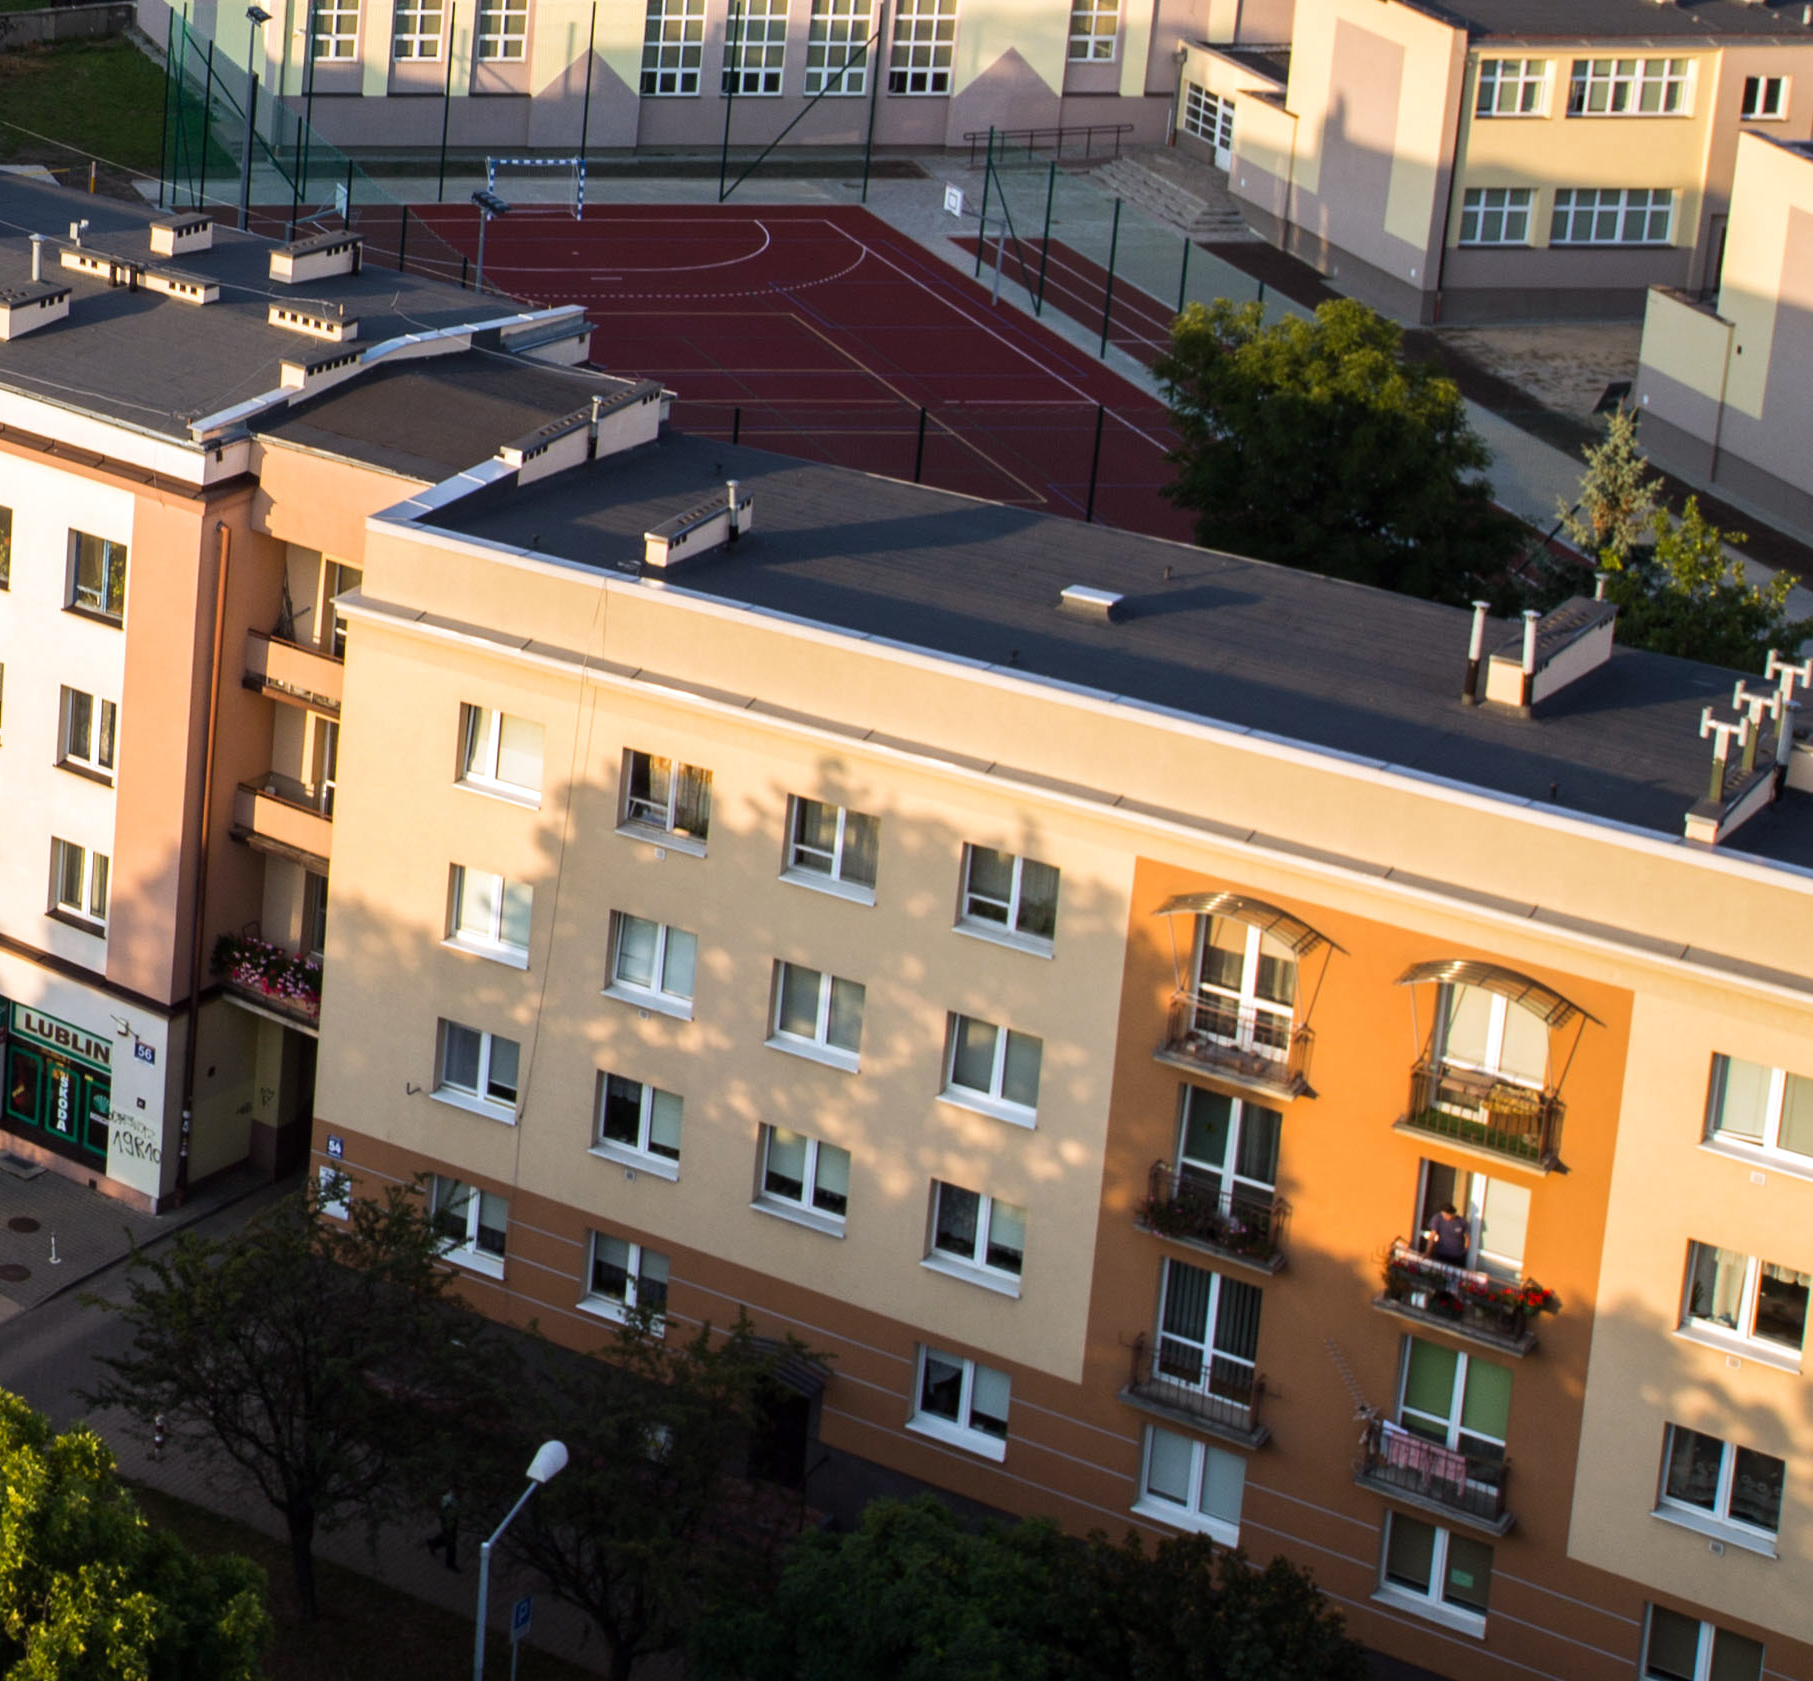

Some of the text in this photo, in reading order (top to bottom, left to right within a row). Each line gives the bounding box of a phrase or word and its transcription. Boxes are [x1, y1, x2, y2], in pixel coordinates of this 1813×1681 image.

[25, 1012, 110, 1065] LUBLIN
[137, 1045, 152, 1061] 56
[328, 1139, 342, 1155] 54
